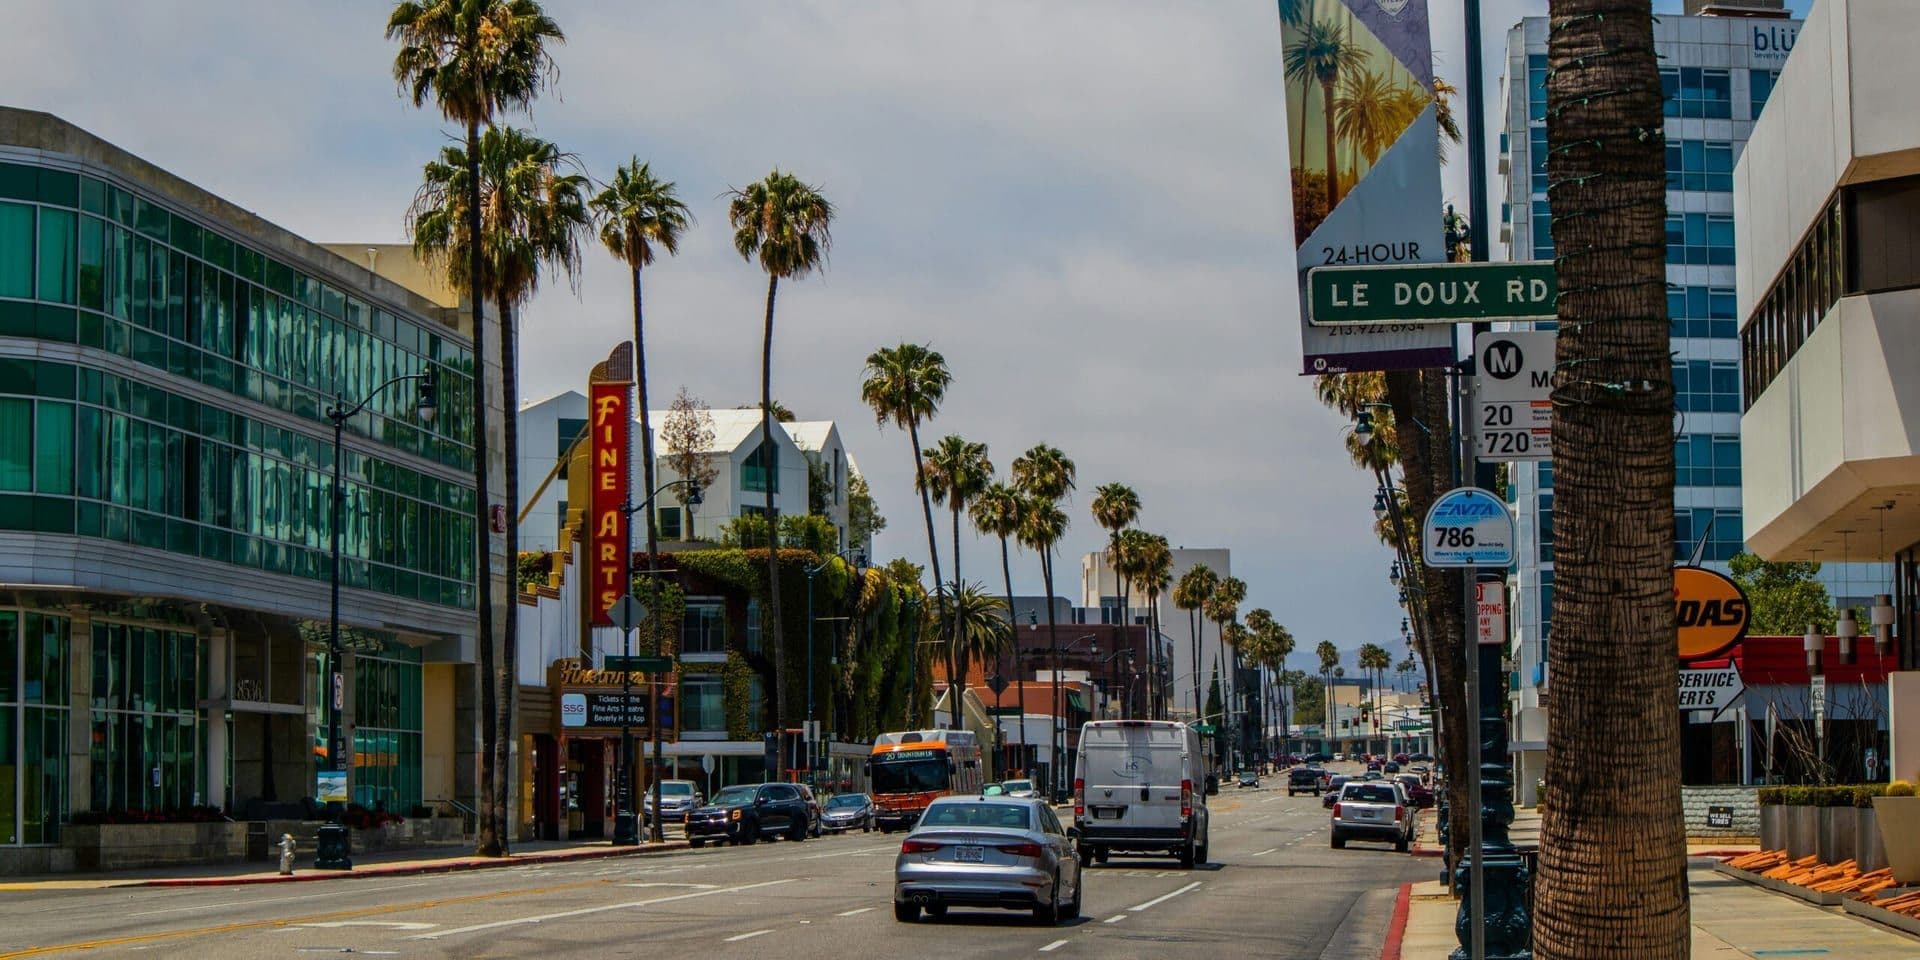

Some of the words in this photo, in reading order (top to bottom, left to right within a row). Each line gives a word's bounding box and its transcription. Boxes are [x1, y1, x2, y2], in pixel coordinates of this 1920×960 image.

[1754, 26, 1796, 51] blü
[1322, 241, 1421, 265] 24-HOUR
[1331, 283, 1369, 307] LE
[1394, 281, 1480, 306] DOUX
[1506, 279, 1548, 303] RD
[1489, 346, 1517, 374] M
[1484, 405, 1513, 426] 20
[595, 396, 620, 490] FINE
[1485, 432, 1529, 453] 720
[1435, 527, 1475, 548] 786
[599, 511, 618, 610] ARTS
[1480, 617, 1490, 625] ANY
[1678, 672, 1736, 688] SERVICE
[563, 704, 585, 712] SSG
[594, 714, 617, 723] Beverly
[886, 753, 896, 761] 20
